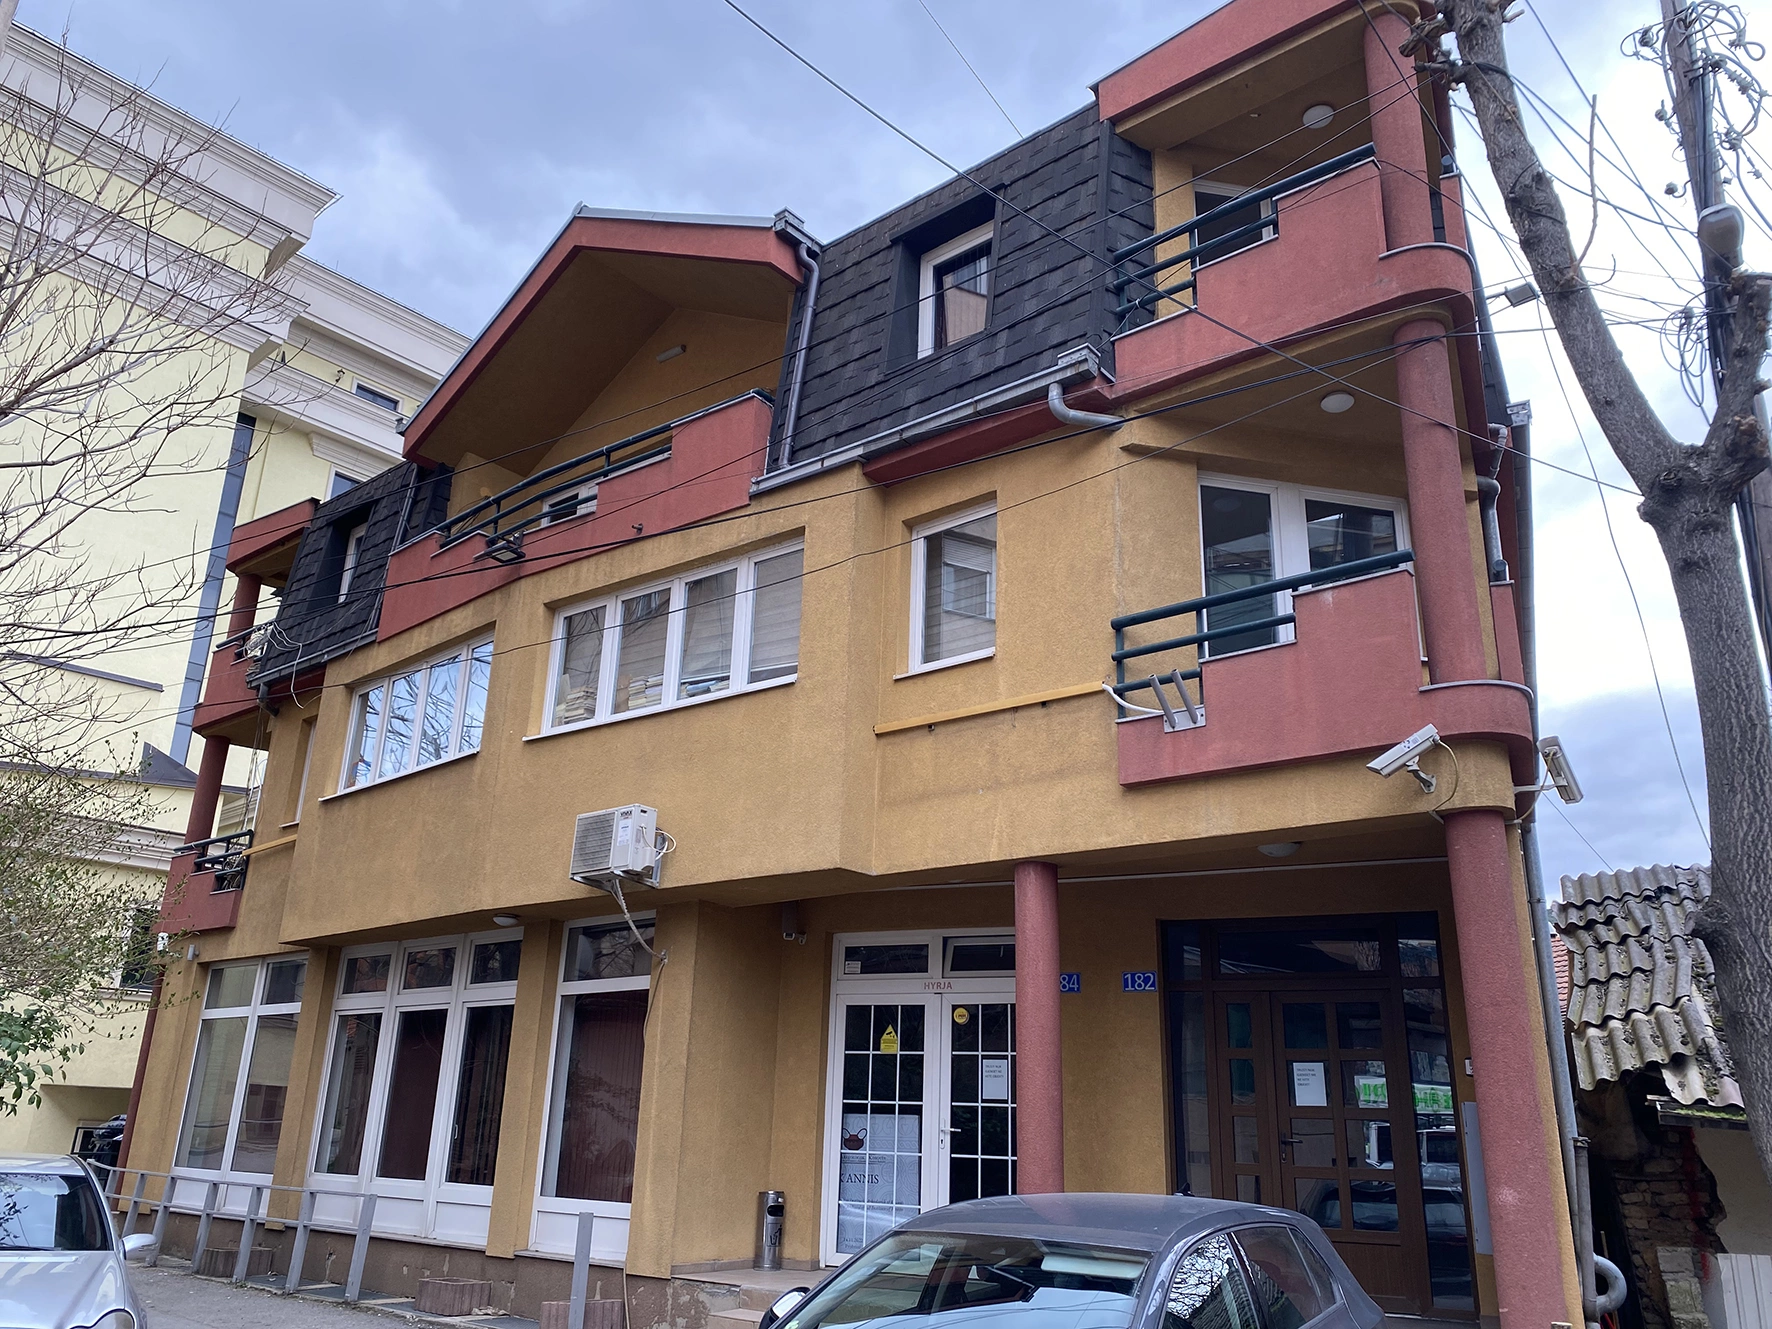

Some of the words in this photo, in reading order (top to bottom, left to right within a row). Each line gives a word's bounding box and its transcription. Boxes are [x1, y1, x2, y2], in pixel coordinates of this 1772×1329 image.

[923, 981, 953, 990] HYRJA
[1060, 974, 1080, 991] 84
[1124, 973, 1155, 991] 182
[846, 1173, 879, 1184] ANNIS
